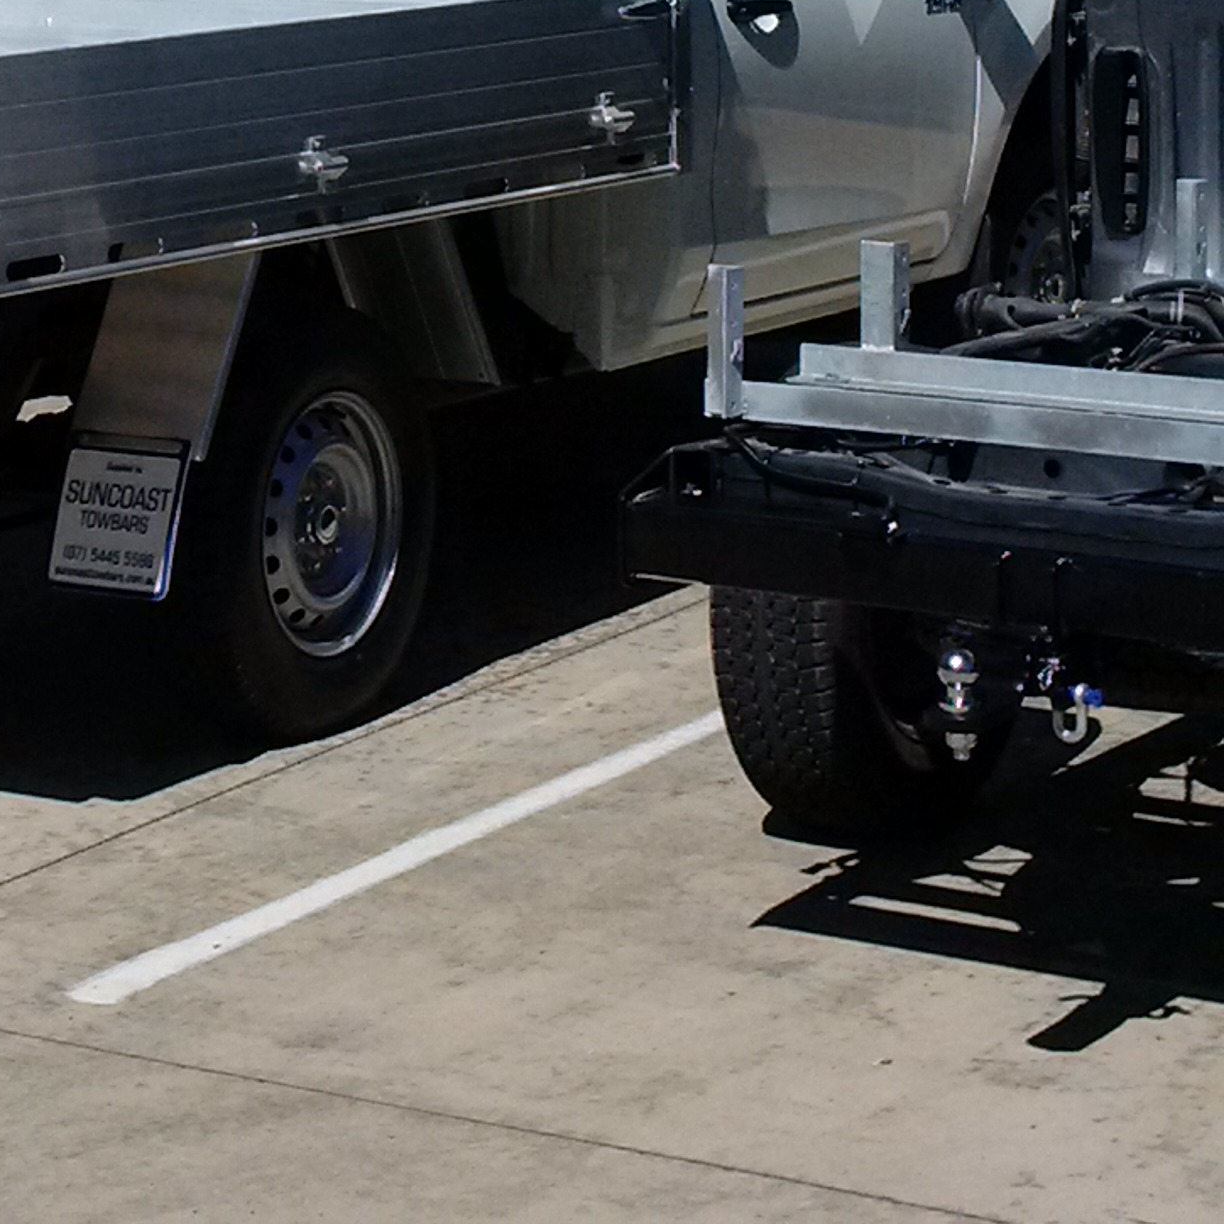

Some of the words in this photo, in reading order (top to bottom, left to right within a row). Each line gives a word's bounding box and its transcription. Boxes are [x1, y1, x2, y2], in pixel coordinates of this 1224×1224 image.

[65, 479, 173, 512] SUNCOAST
[80, 509, 150, 534] TOWBARS
[90, 547, 122, 566] 5445
